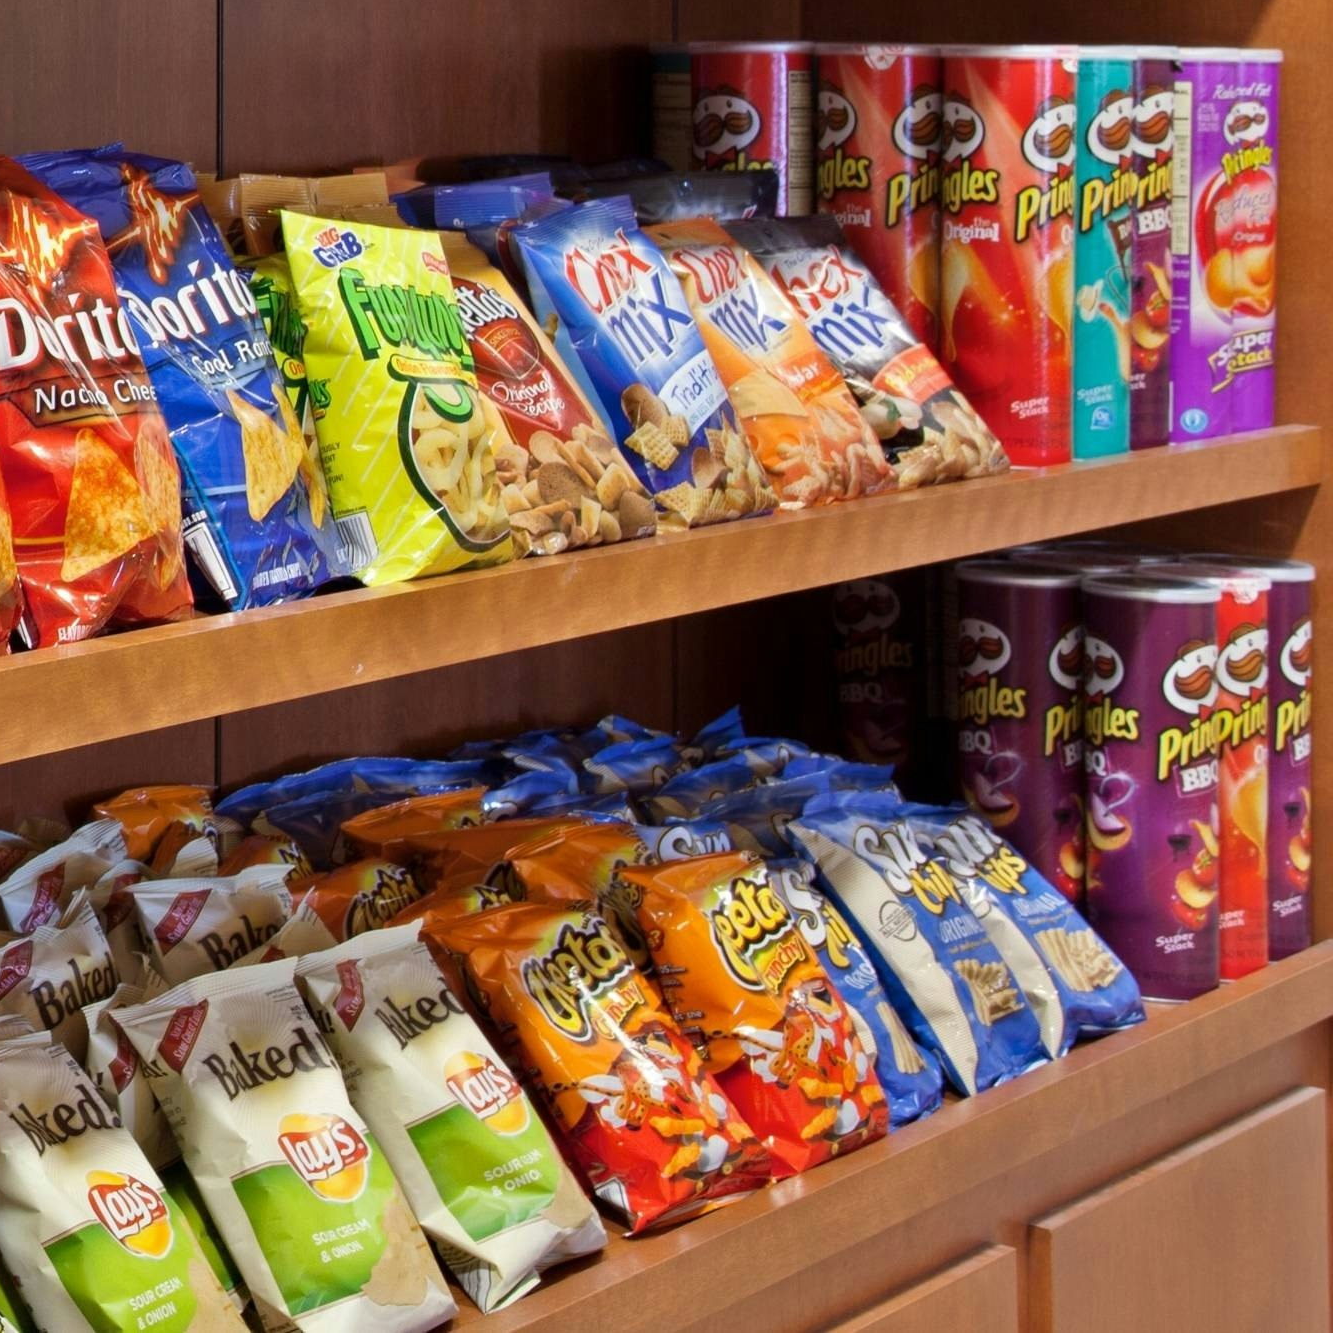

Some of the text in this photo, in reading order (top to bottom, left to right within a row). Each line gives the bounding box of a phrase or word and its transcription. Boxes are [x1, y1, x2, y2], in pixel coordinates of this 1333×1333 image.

[1015, 175, 1075, 244] Pring
[116, 258, 258, 344] Dorito
[709, 280, 789, 354] mix
[606, 270, 695, 369] mix
[191, 351, 235, 377] Cool
[34, 381, 109, 416] Nacho
[490, 374, 557, 409] Original
[1010, 396, 1050, 415] Super
[1019, 406, 1050, 421] Stack
[1157, 714, 1221, 784] Pring
[1156, 931, 1196, 950] Super
[1163, 941, 1196, 955] Stack
[449, 1056, 515, 1120] Lay's
[281, 1115, 363, 1182] Lay's
[89, 1173, 163, 1242] Lay's
[335, 1216, 371, 1243] CREAM
[332, 1238, 364, 1261] ONION
[128, 1274, 185, 1312] SOUR CREAM
[147, 1301, 177, 1328] ONION
